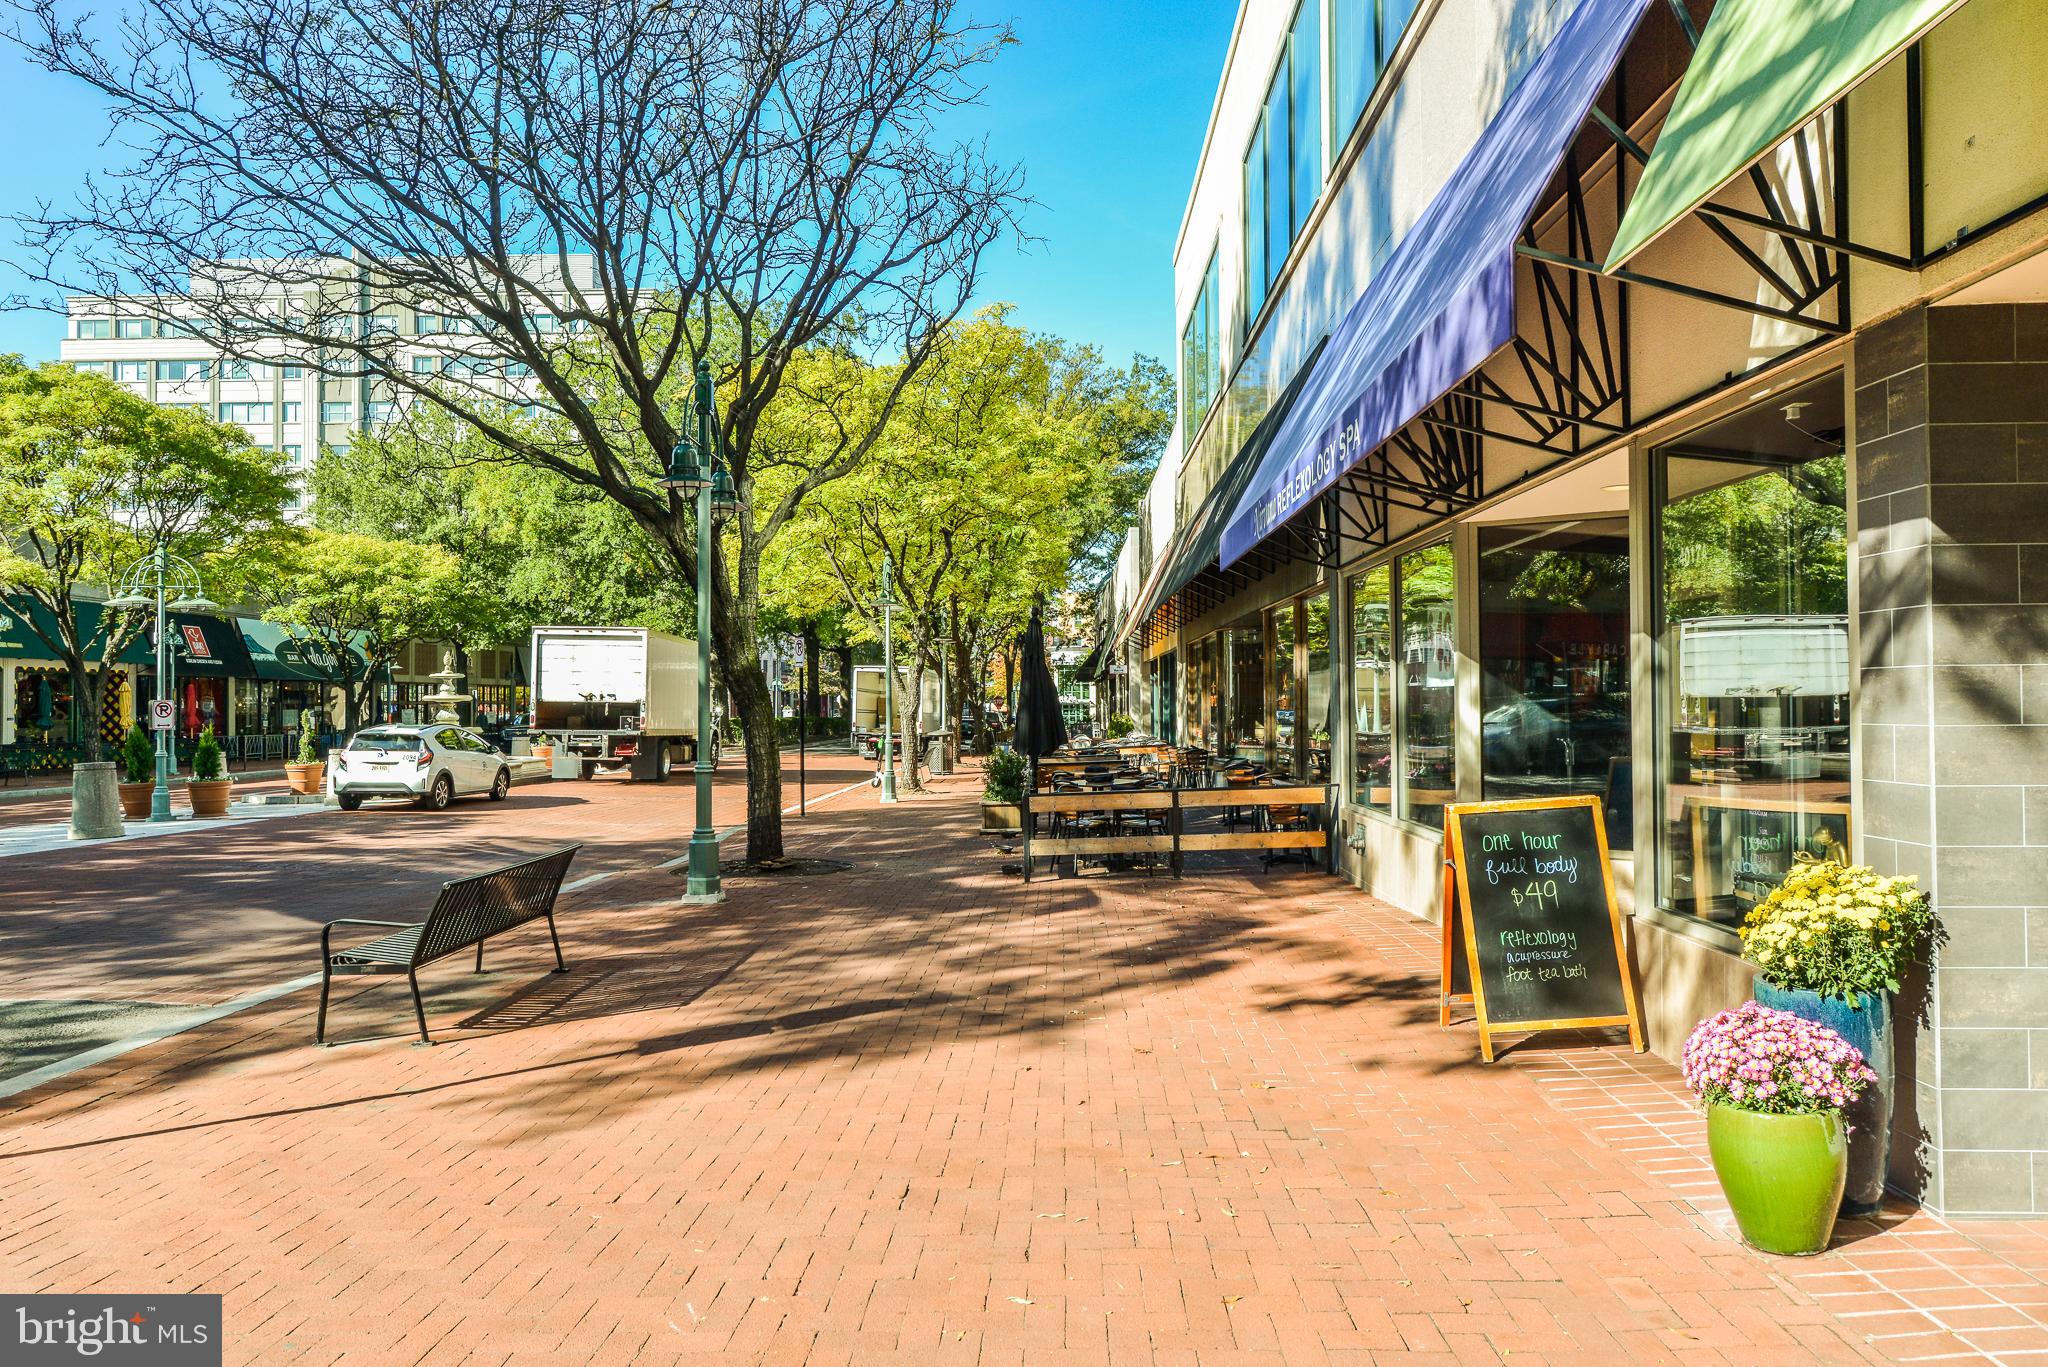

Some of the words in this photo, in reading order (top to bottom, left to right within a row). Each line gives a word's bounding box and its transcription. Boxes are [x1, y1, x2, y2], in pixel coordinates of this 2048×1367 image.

[1277, 439, 1337, 516] REFLEXOLOGY
[1340, 418, 1361, 461] SPA
[1483, 834, 1514, 852] one
[1521, 831, 1562, 850] hour
[1485, 857, 1528, 885] full
[1534, 855, 1578, 884] body
[1510, 880, 1559, 911] $49
[1500, 929, 1577, 950] reflexology
[1506, 950, 1573, 963] acupressure
[1506, 965, 1533, 982] foot
[1538, 967, 1560, 982] tea
[1562, 963, 1588, 980] bath
